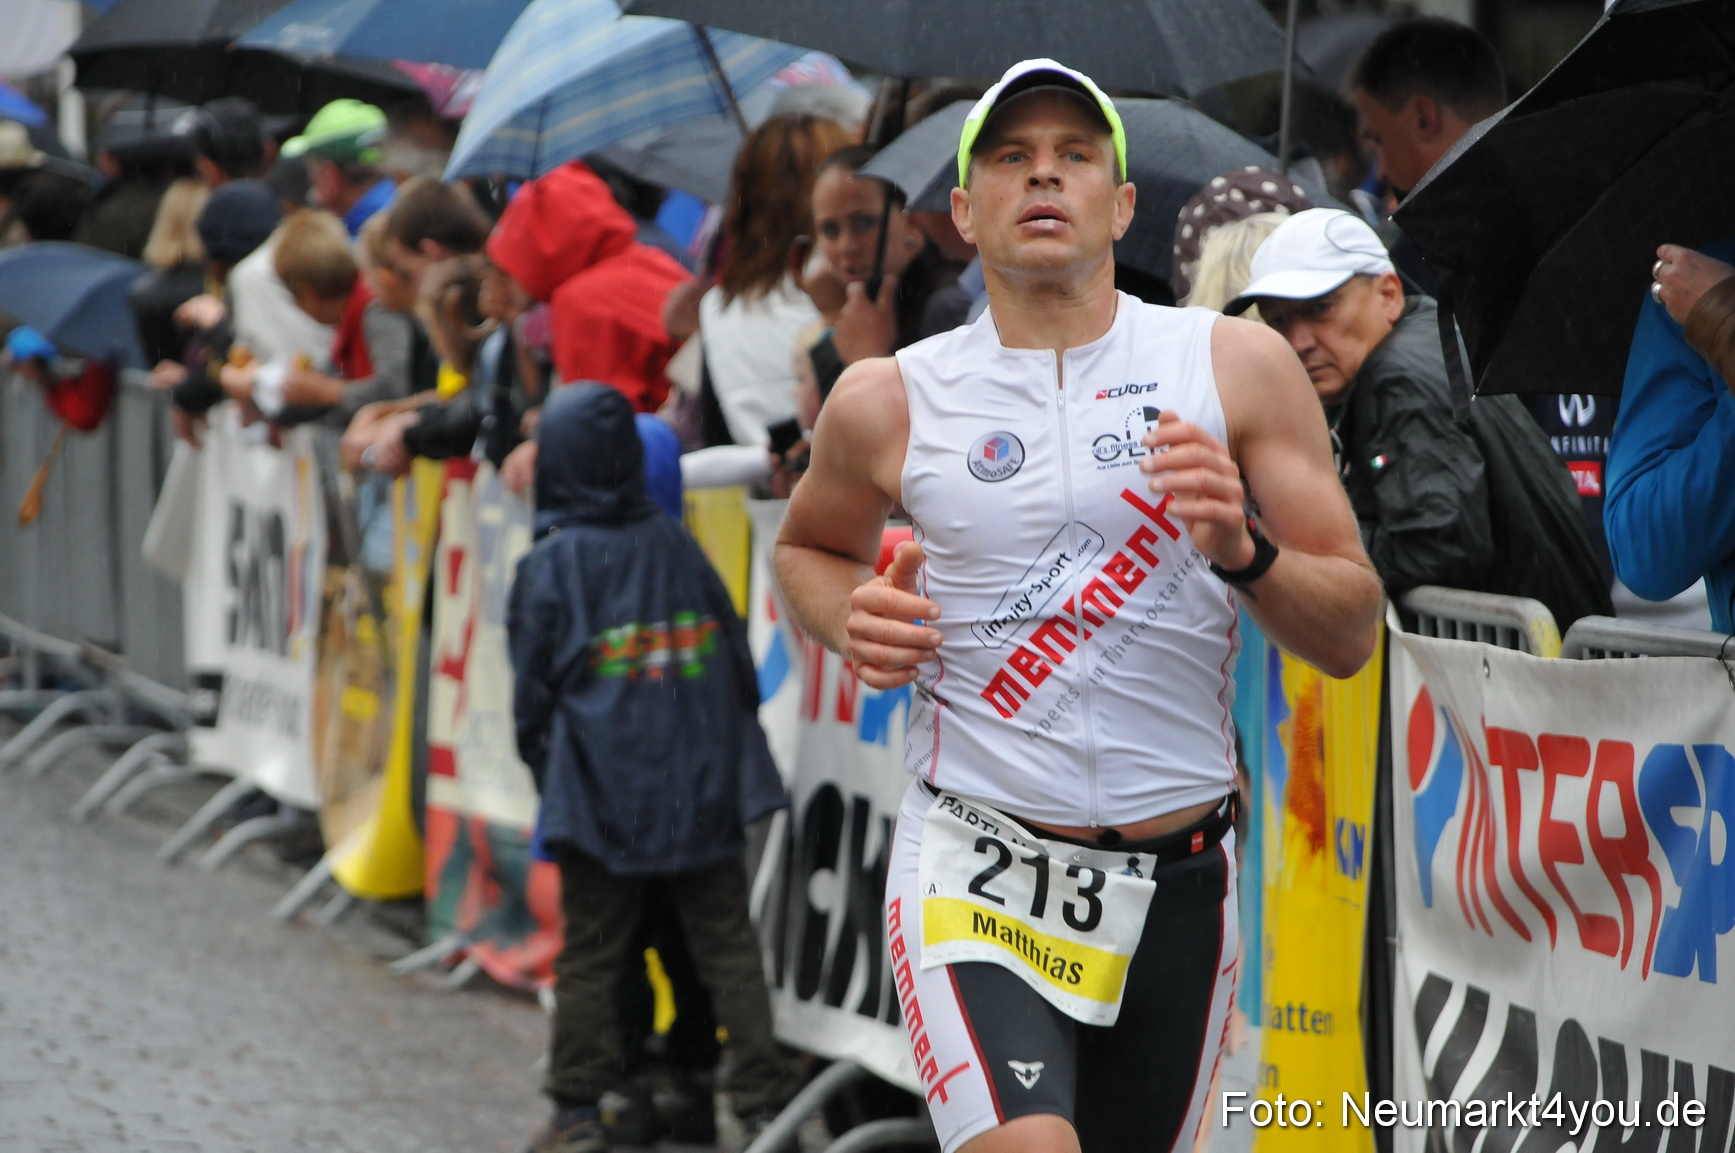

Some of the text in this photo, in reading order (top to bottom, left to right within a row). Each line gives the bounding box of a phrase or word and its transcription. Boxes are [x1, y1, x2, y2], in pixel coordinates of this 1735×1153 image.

[980, 487, 1182, 719] memmert
[967, 836, 1107, 932] 213
[973, 911, 1084, 986] Matthias
[888, 896, 970, 1105] memmert
